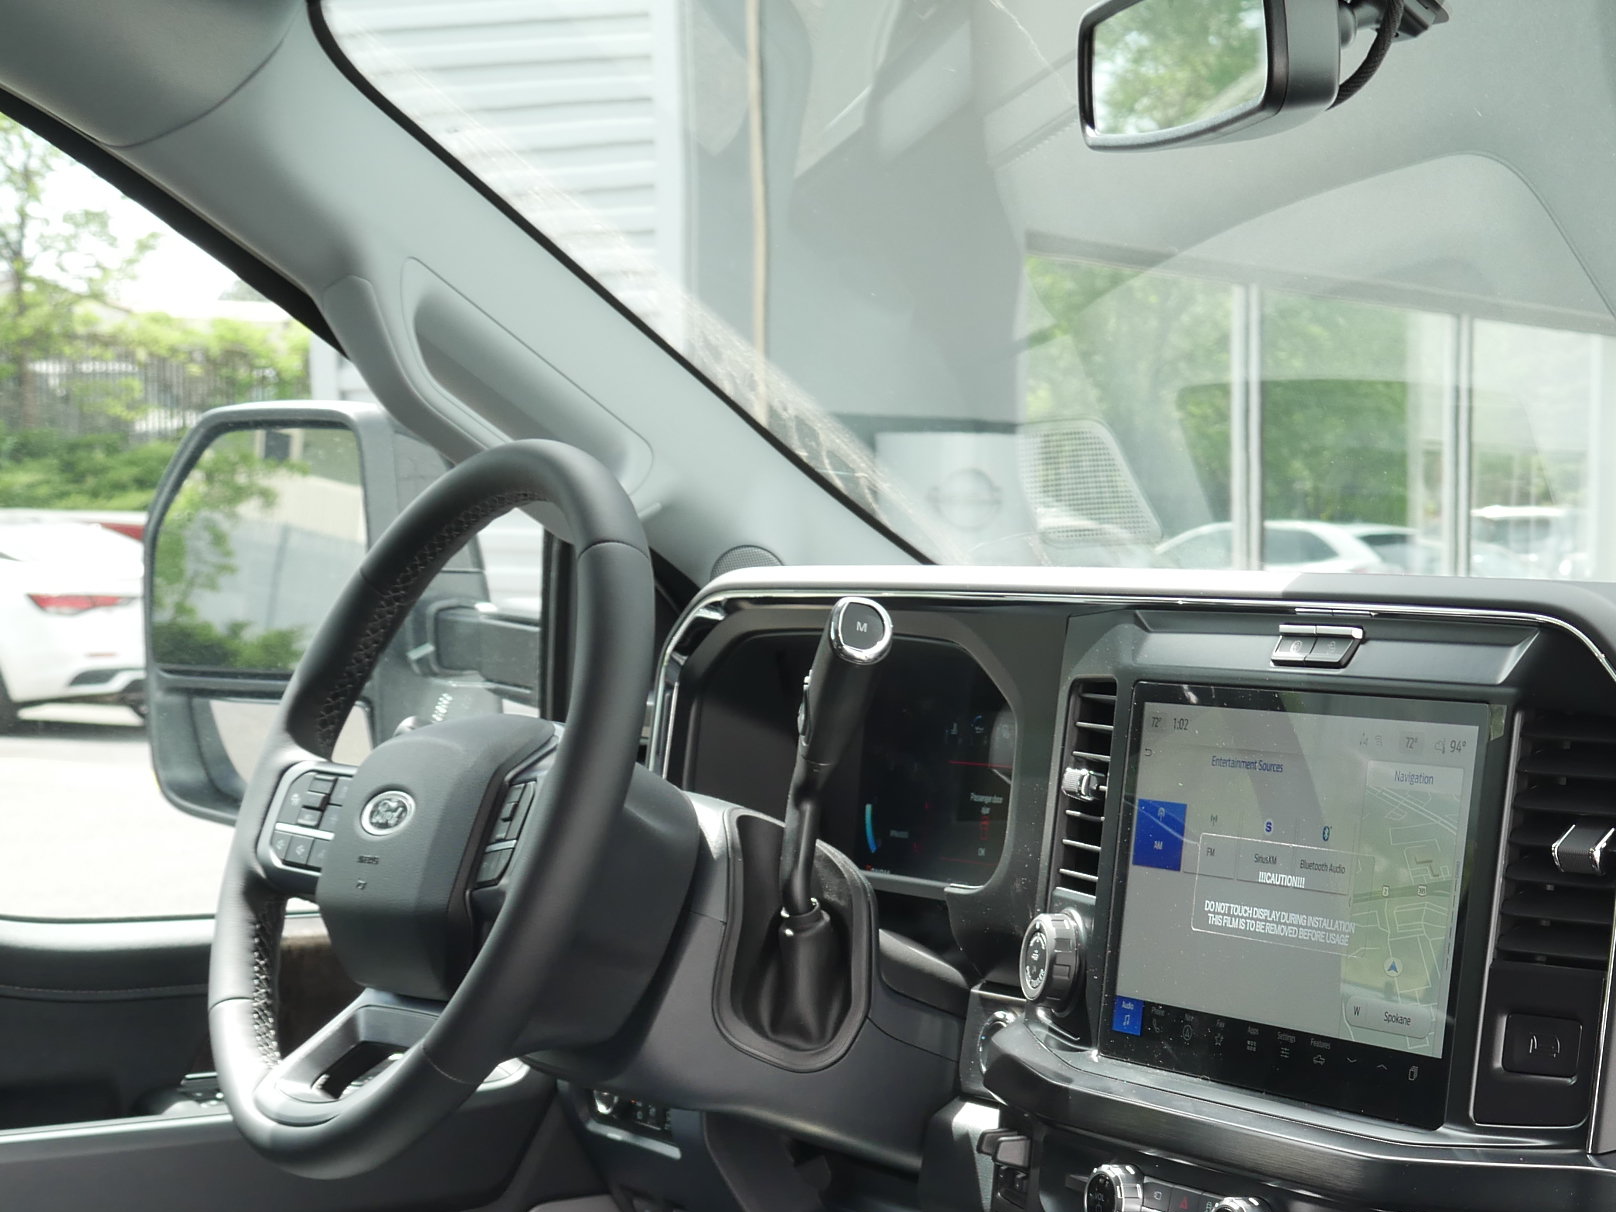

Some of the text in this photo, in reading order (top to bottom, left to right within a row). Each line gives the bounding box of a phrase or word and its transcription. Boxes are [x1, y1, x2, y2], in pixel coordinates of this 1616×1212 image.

[856, 620, 868, 633] M
[1173, 717, 1189, 731] 1:02
[1450, 739, 1467, 753] 94°
[1211, 755, 1284, 773] Entertainment Sources
[1394, 770, 1434, 785] Navigation
[1300, 859, 1346, 874] Bluetooth Audio
[1204, 900, 1356, 934] DO NOT TOUCH DISPLAY DURING INSTALLATION
[1207, 913, 1350, 947] THIS FILM IS TO BE REMOVED BEFORE USAGE
[1353, 1006, 1361, 1017] W
[1383, 1011, 1412, 1026] Spokane
[1310, 1038, 1332, 1050] Features
